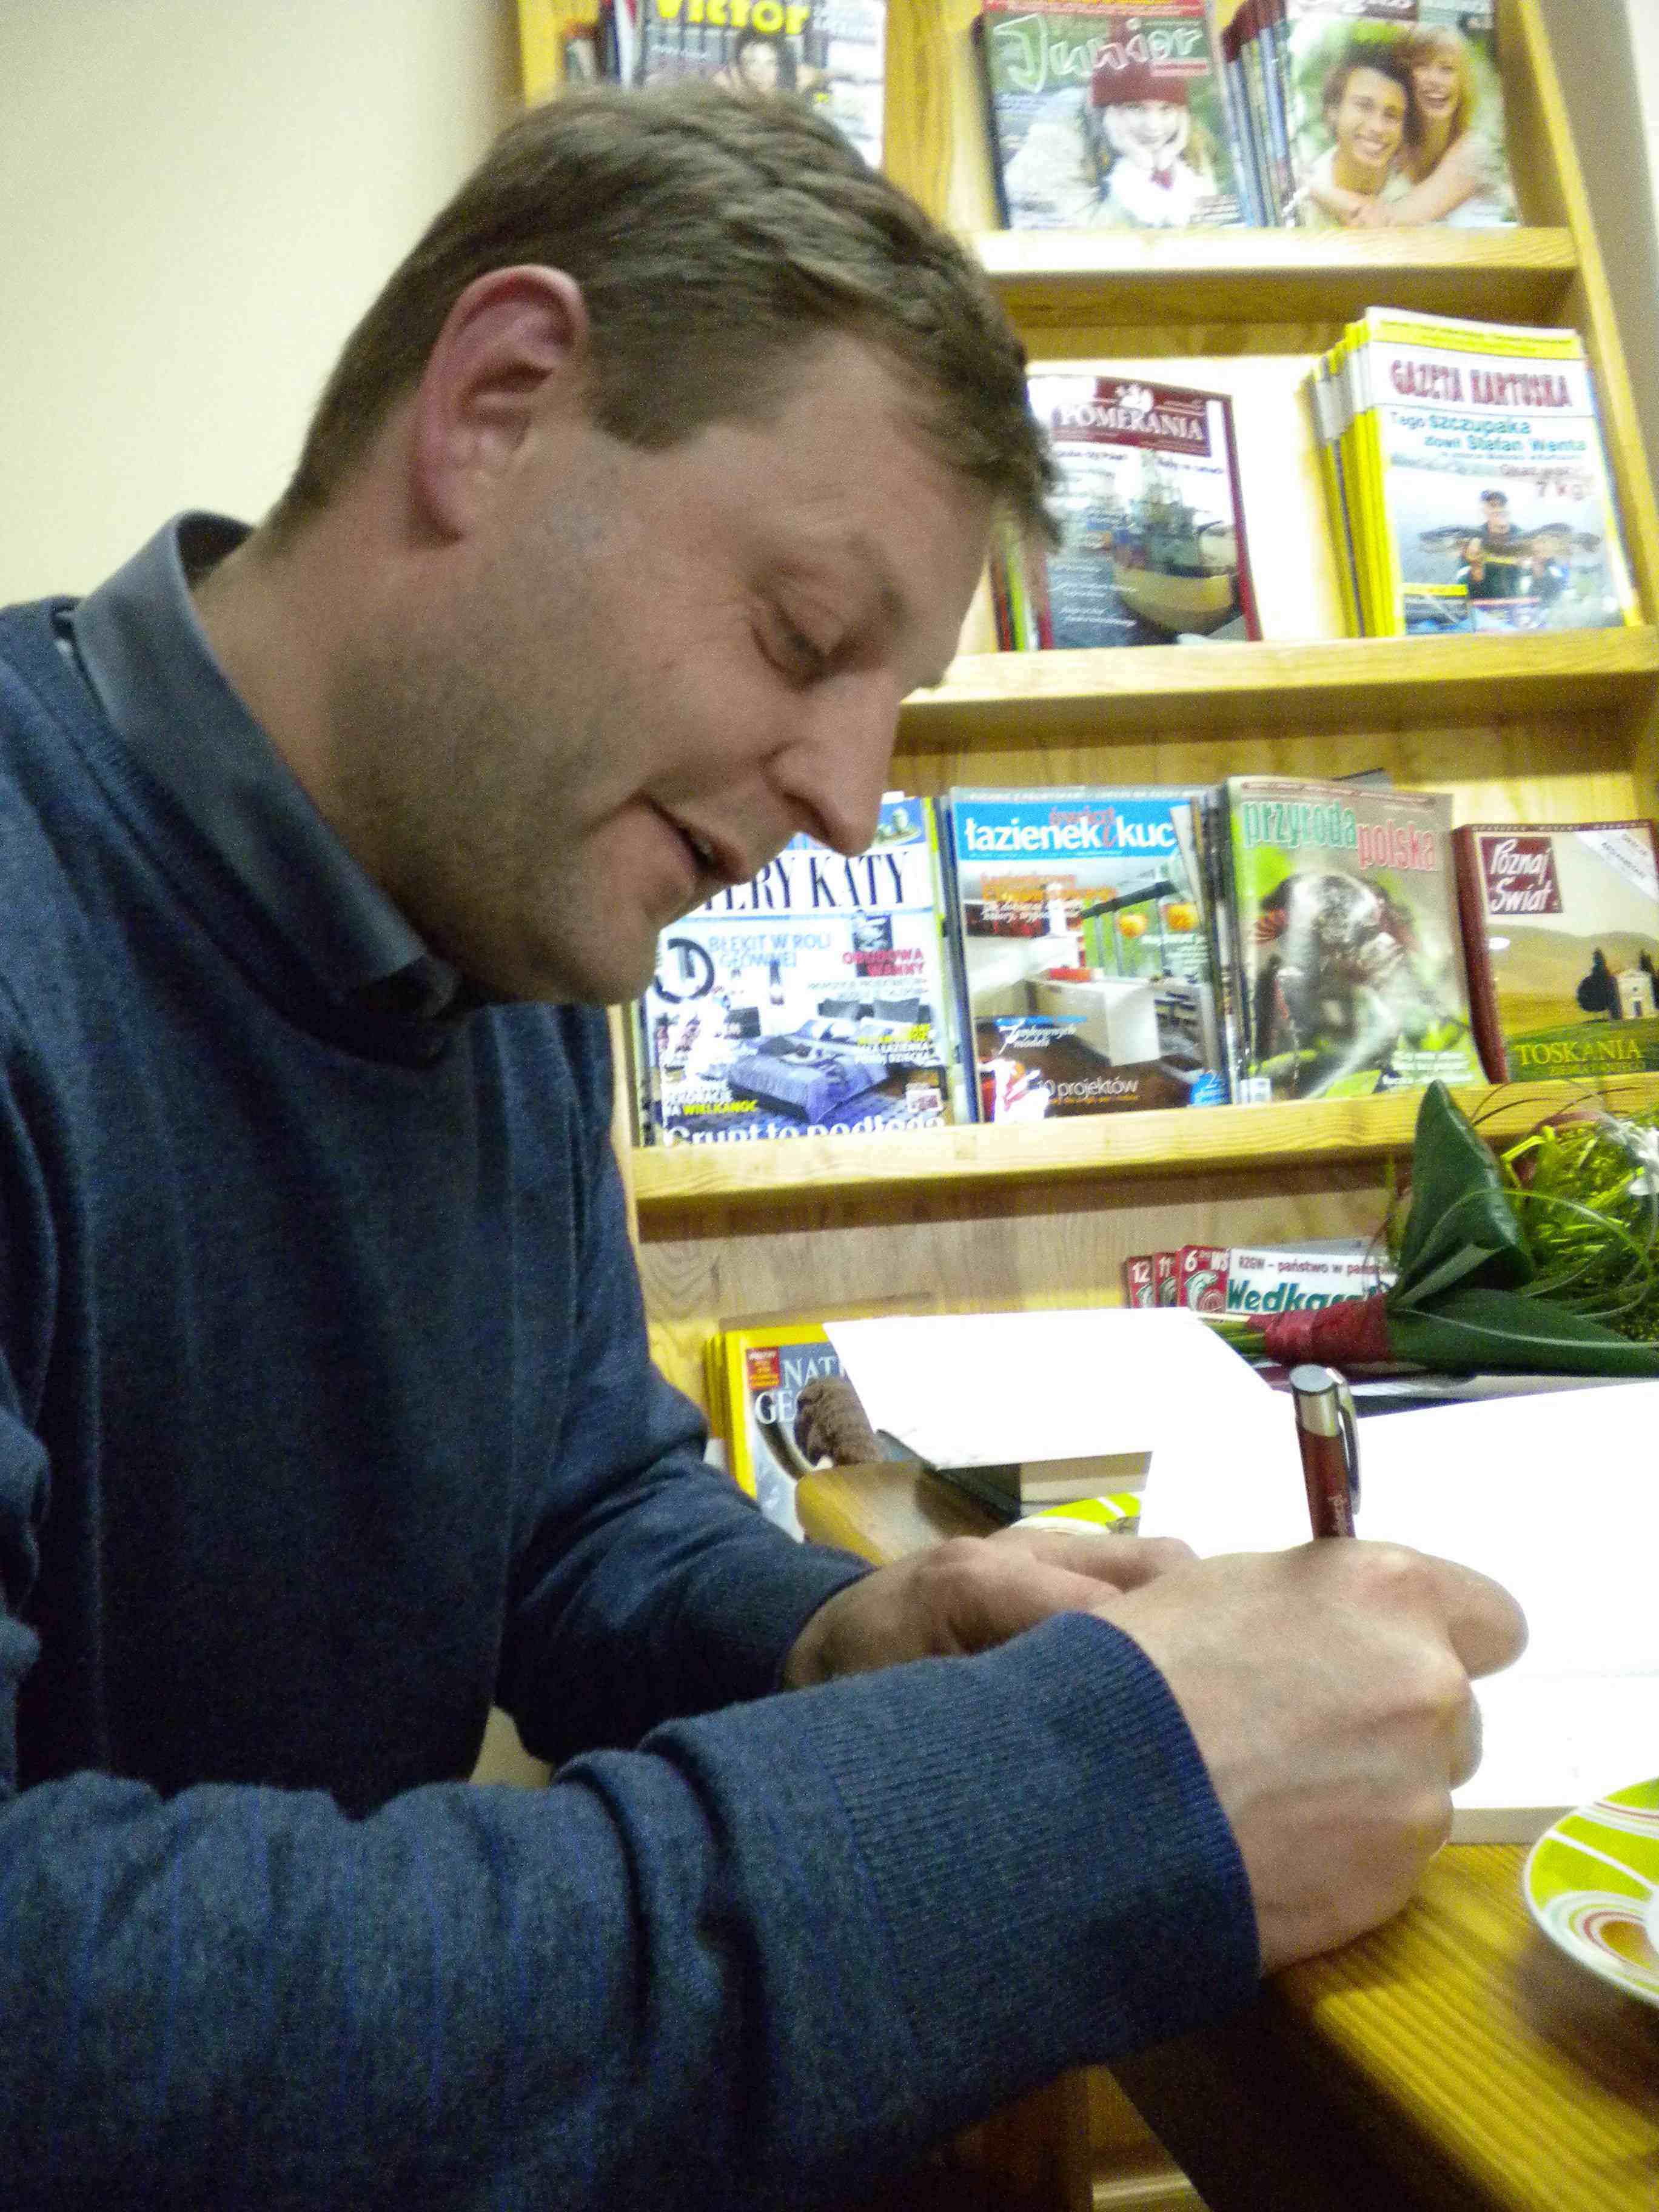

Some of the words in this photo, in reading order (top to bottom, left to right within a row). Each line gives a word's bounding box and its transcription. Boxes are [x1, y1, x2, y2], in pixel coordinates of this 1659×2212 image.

[1391, 360, 1464, 402] GAZETA
[1470, 369, 1572, 407] KARTUSKA
[1061, 403, 1203, 440] POMERANIA
[965, 816, 1102, 851] łazienek
[1242, 800, 1357, 849] przyroda
[1357, 819, 1437, 871] polska
[1490, 839, 1552, 886] Poznaj
[1516, 1039, 1643, 1066] TOSKANIA
[1057, 1076, 1139, 1102] projektów
[1131, 1261, 1151, 1284] 12
[1184, 1250, 1198, 1272] 6
[1332, 1264, 1343, 1273] w
